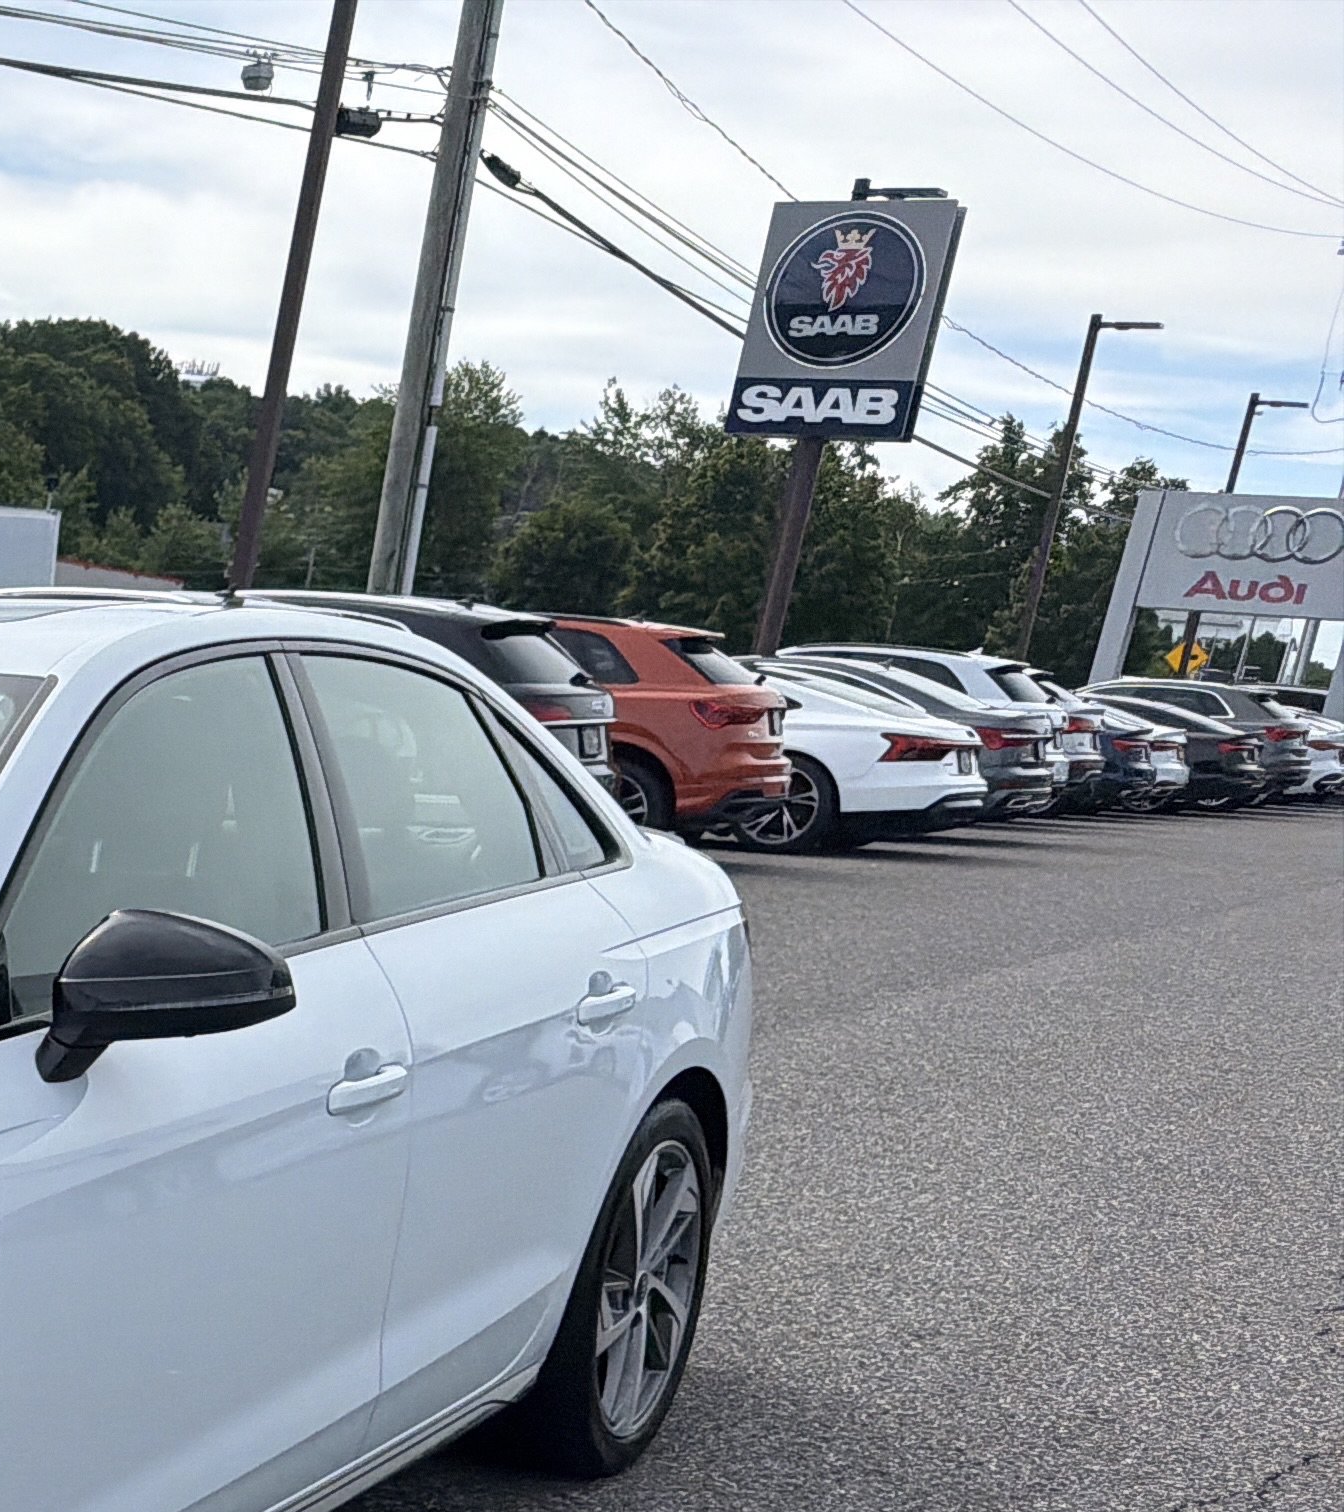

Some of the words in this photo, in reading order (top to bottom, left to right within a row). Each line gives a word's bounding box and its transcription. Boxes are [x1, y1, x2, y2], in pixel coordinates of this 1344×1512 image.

[787, 313, 880, 338] SAAB
[737, 385, 899, 425] SAAB
[1183, 570, 1308, 605] Audi
